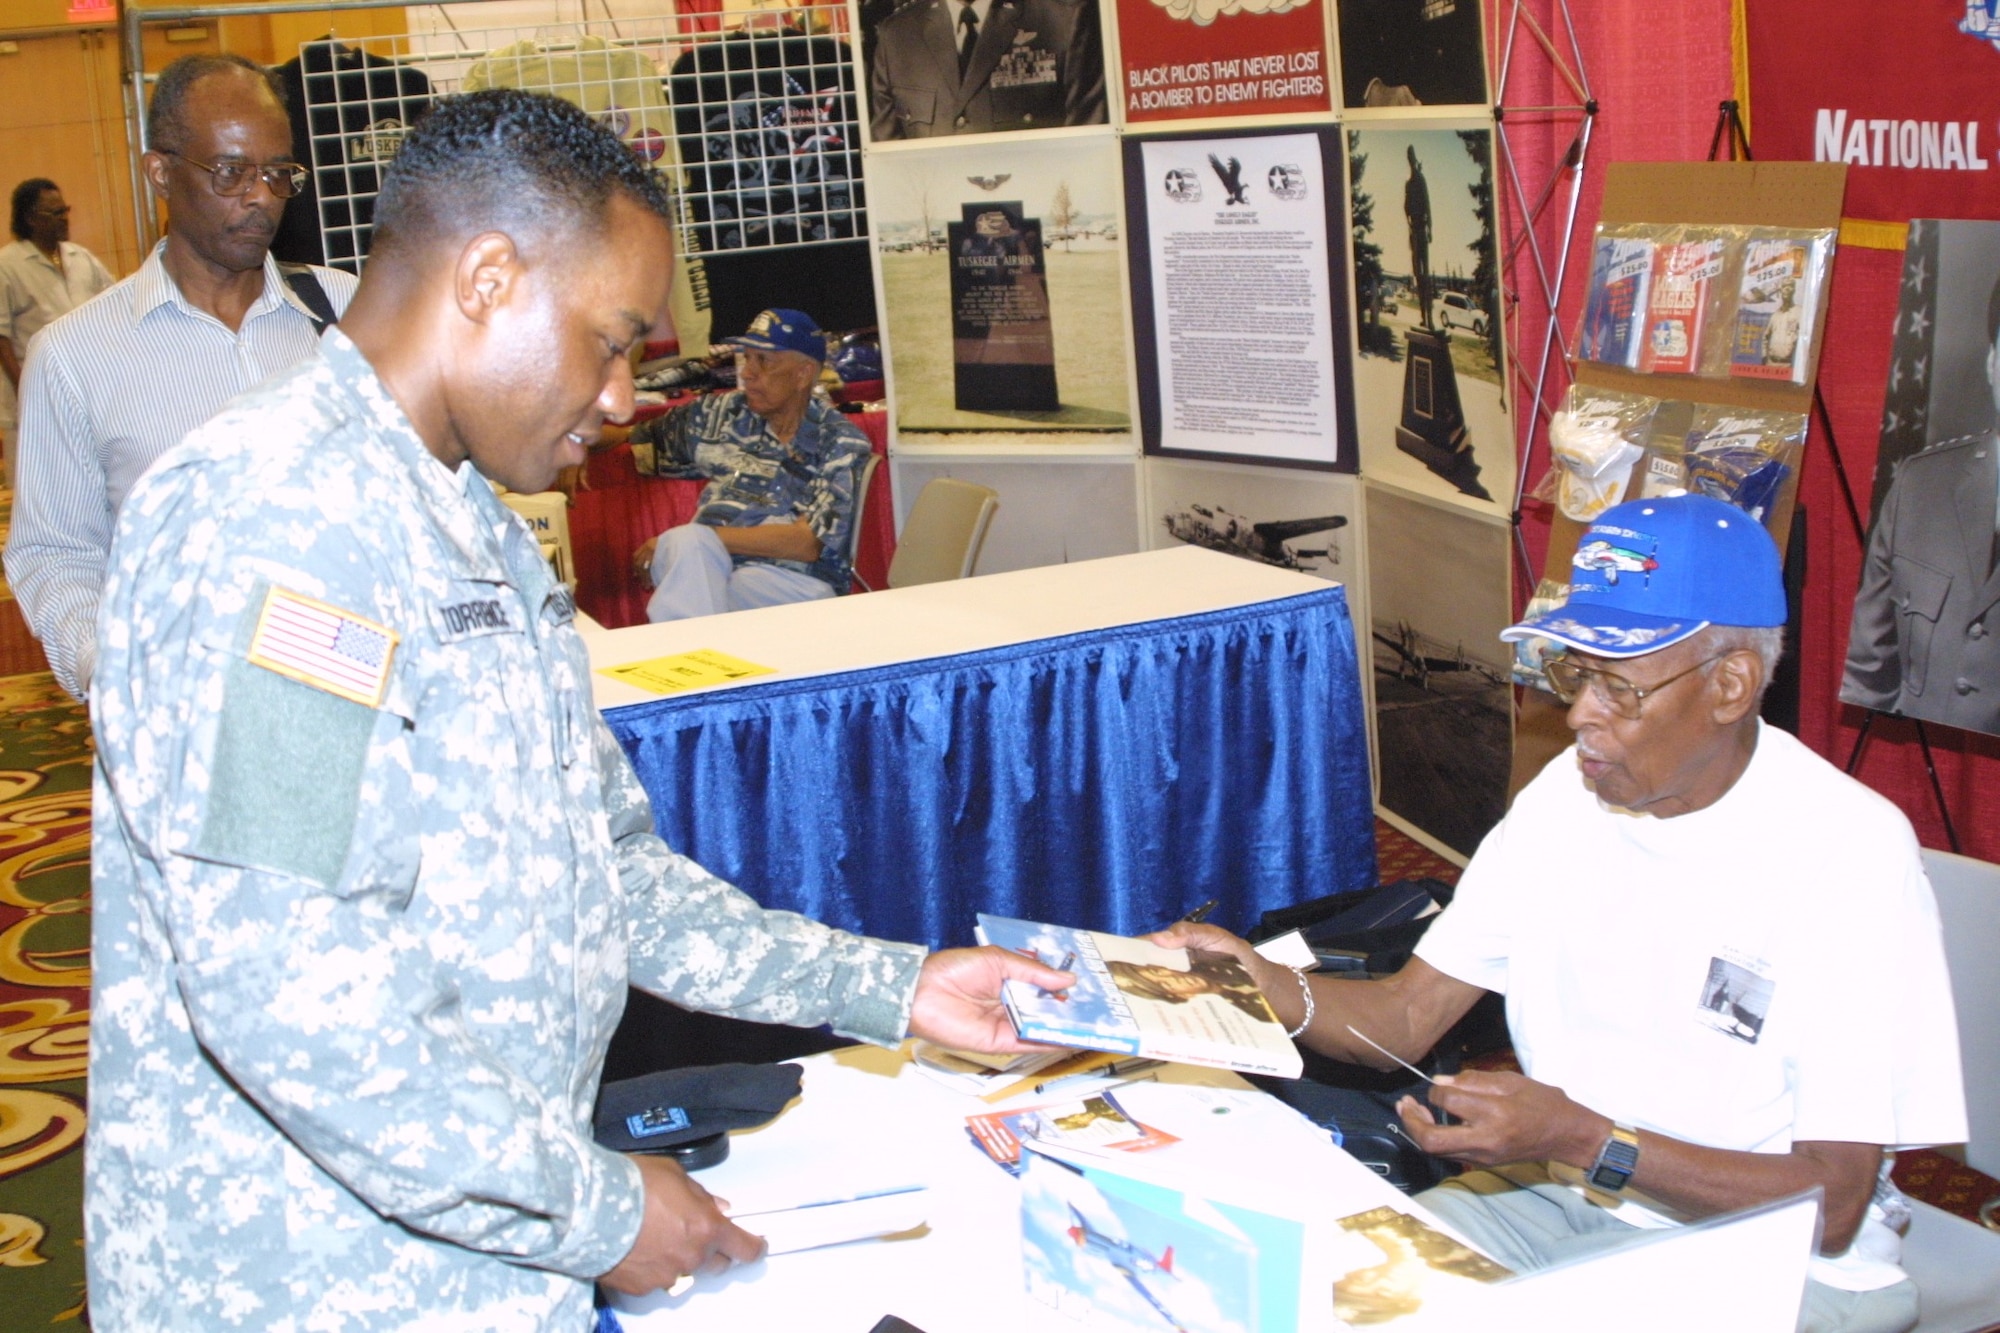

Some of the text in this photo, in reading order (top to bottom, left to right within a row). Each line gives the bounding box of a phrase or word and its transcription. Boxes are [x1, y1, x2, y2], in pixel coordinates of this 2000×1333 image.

[1129, 51, 1320, 88] BLACK PILOTS THAT NEVER LOST
[1129, 75, 1324, 110] A BOMBER TO ENEMY FIGHTERS
[958, 254, 1035, 267] TUSKEGEE AIRMEN
[1757, 266, 1787, 282] $25.00
